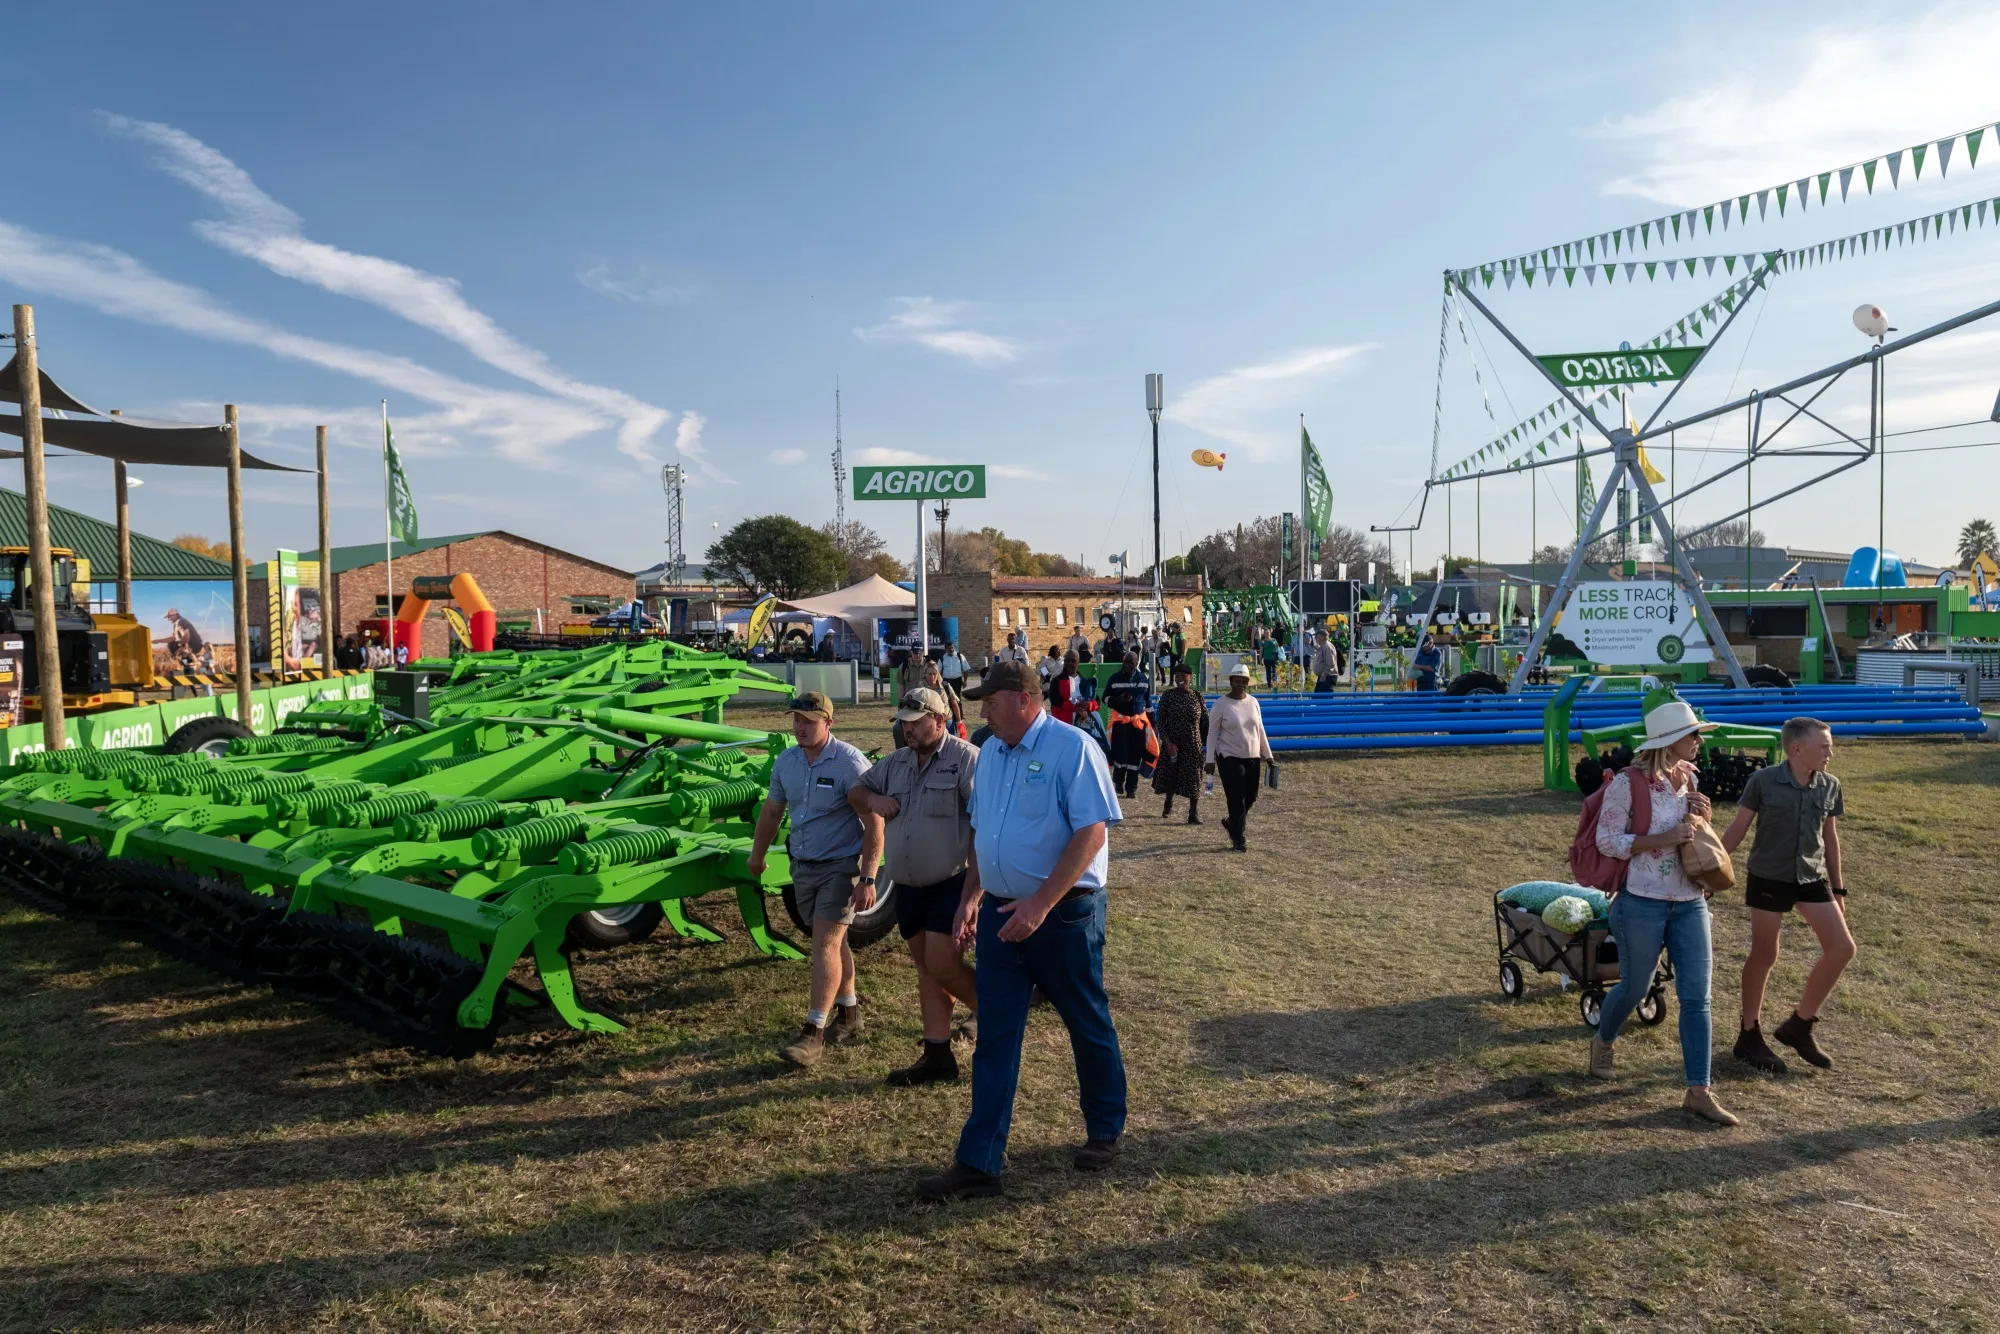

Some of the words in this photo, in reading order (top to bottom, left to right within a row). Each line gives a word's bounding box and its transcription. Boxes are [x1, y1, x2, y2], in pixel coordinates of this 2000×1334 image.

[862, 469, 975, 494] AGRICO
[1305, 441, 1324, 515] GRIC
[1579, 589, 1619, 603] LESS
[1624, 588, 1676, 602] TRACK
[1579, 606, 1629, 620] MORE
[1633, 605, 1679, 619] CROP
[231, 703, 264, 726] ACO
[276, 695, 307, 720] AGRICO
[102, 722, 153, 750] AGRICO
